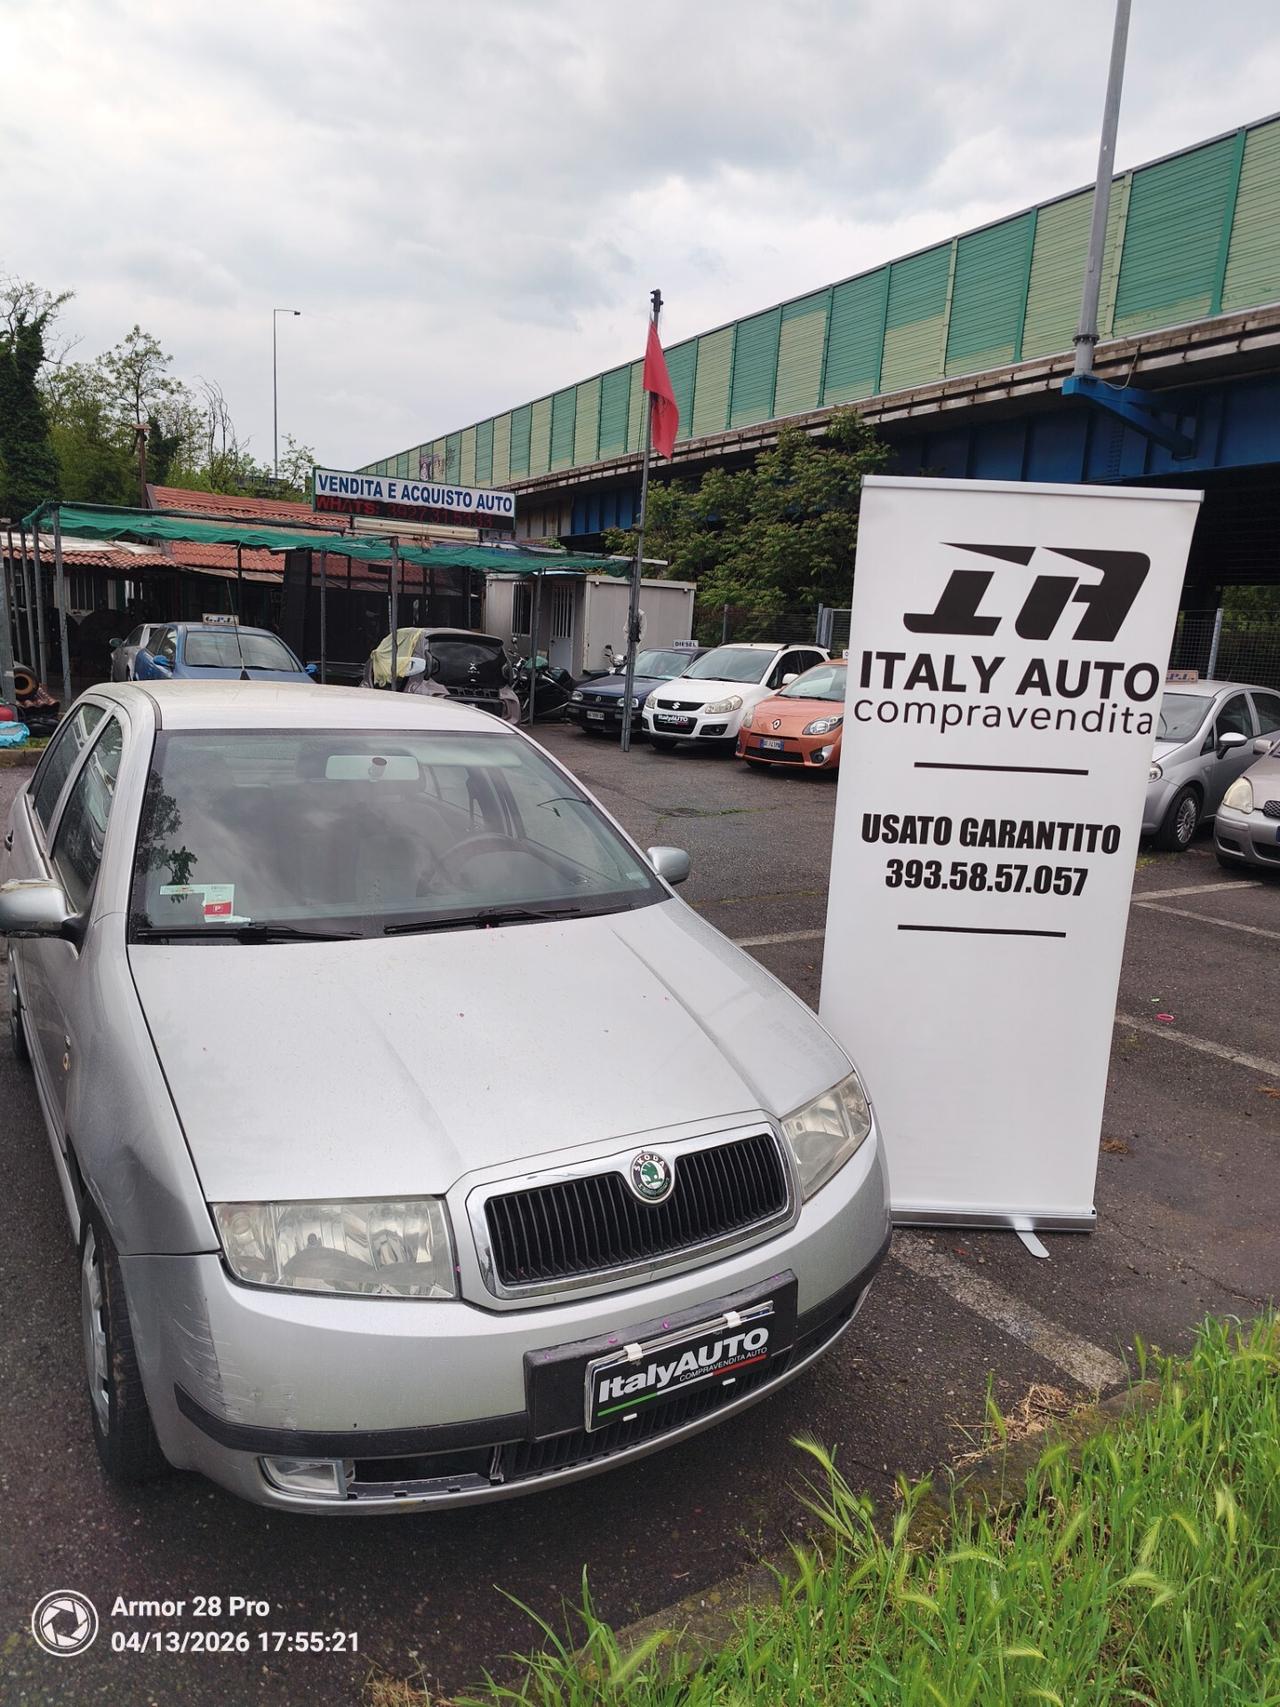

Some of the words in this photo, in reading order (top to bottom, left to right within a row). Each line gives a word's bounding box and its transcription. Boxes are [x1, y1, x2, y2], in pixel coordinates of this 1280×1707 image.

[318, 474, 383, 498] VENDITA
[388, 483, 397, 499] E
[401, 485, 473, 508] ACQUISTO
[476, 493, 513, 513] AUTO
[860, 650, 1006, 694] ITALY
[1015, 658, 1160, 703] AUTO
[854, 699, 1153, 735] compravendita
[861, 813, 952, 846] USATO
[959, 817, 1121, 855] GARANTITO
[885, 858, 1088, 897] 393.58.57.057
[679, 1354, 745, 1382] COMPRAVENDITA
[746, 1347, 768, 1360] AUTO
